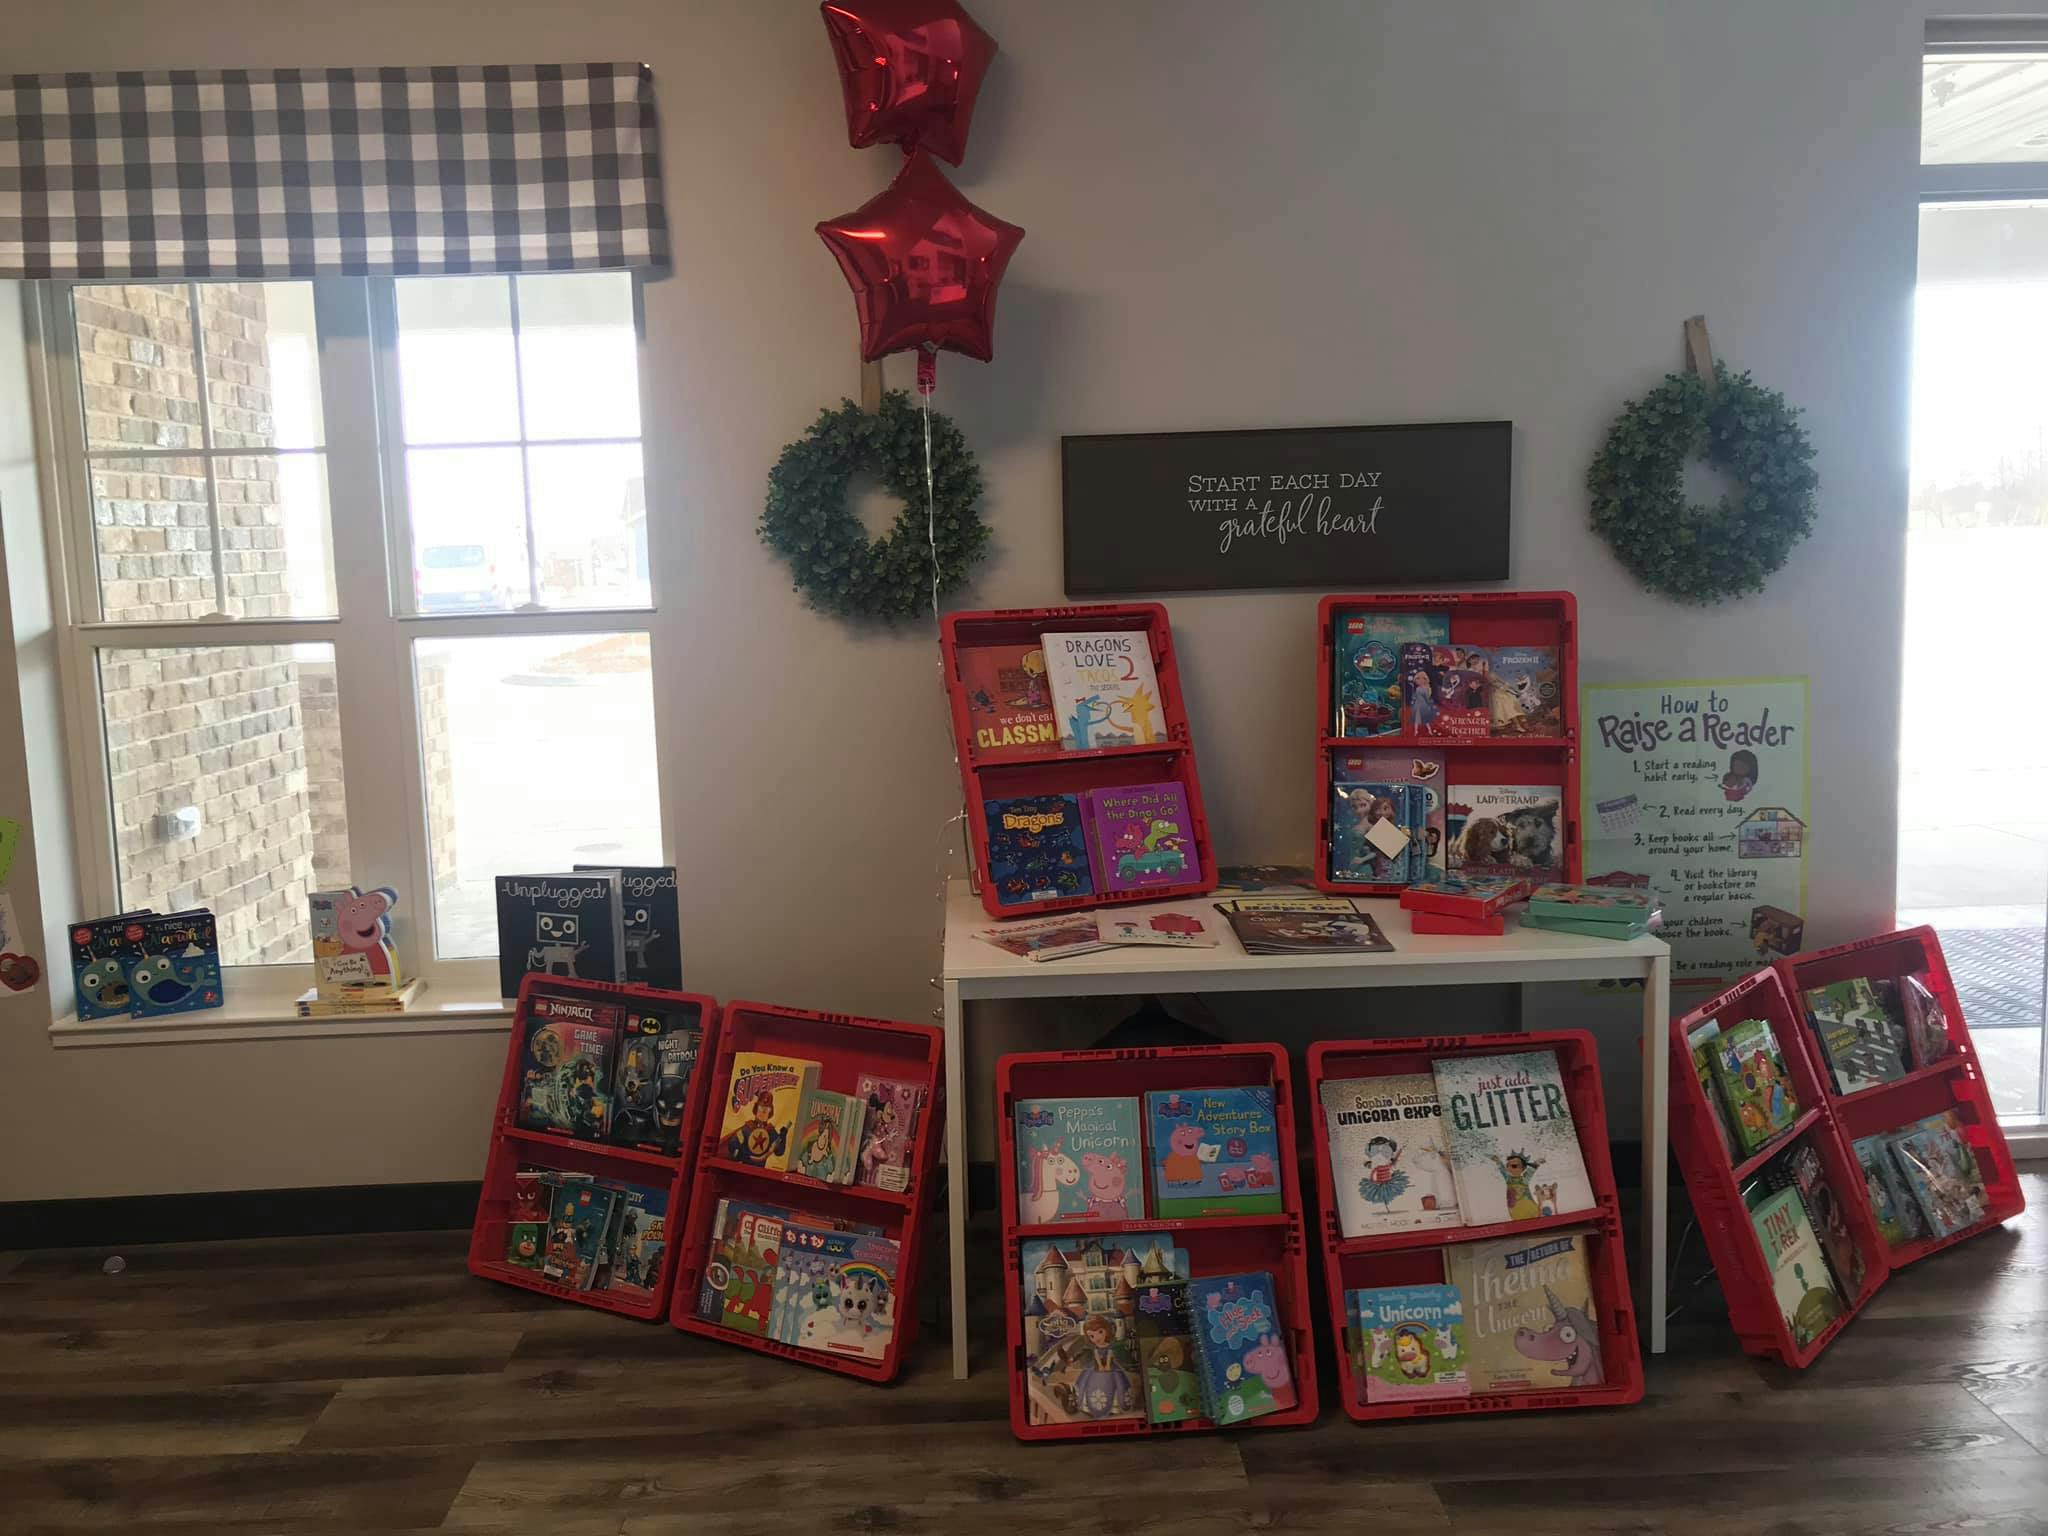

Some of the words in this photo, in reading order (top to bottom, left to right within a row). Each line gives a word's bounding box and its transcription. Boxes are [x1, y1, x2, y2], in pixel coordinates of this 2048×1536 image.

[1188, 474, 1261, 494] START
[1270, 473, 1330, 491] EACH
[1339, 471, 1383, 488] DAY
[1188, 498, 1238, 513] WITH
[1244, 497, 1259, 511] A
[1218, 493, 1313, 553] grateful
[1316, 495, 1385, 536] heart
[1065, 638, 1132, 653] DRAGONS
[1074, 653, 1117, 668] LOVE
[1117, 655, 1139, 682] 2
[1076, 669, 1119, 684] TACOS
[1661, 694, 1699, 714] How
[1707, 689, 1729, 713] to
[1000, 716, 1014, 725] we
[1015, 712, 1037, 723] don't
[976, 722, 1056, 749] CLASSM
[1597, 711, 1673, 753] Raise
[1678, 716, 1696, 742] a
[1702, 707, 1795, 750] Reader
[1645, 760, 1669, 770] Start
[1673, 761, 1679, 769] a
[1682, 759, 1717, 771] reading
[1644, 771, 1668, 782] habit
[1103, 796, 1138, 808] Where
[1142, 793, 1160, 805] Did
[1163, 792, 1178, 803] All
[1476, 794, 1499, 805] LADY
[1505, 794, 1539, 805] TRAMP
[1107, 810, 1125, 820] the
[1659, 805, 1670, 818] 2.
[1673, 805, 1696, 816] Read
[1699, 806, 1724, 817] every
[1003, 812, 1065, 833] Dragons
[1633, 832, 1645, 846] 3.
[1648, 833, 1670, 845] Keep
[1672, 832, 1699, 843] books
[1703, 831, 1714, 841] all
[1648, 843, 1680, 855] around
[1683, 845, 1705, 857] your
[1684, 868, 1704, 879] Visit
[1708, 868, 1724, 878] the
[1727, 867, 1758, 880] library
[622, 873, 677, 897] ugged
[1684, 882, 1694, 890] or
[1697, 880, 1741, 890] bookstore
[502, 880, 607, 908] Unplugged
[1693, 892, 1725, 905] regular
[1688, 916, 1723, 926] children
[1686, 927, 1701, 937] the
[1676, 960, 1686, 970] Be
[1699, 959, 1733, 972] reading
[574, 1029, 599, 1042] GAME
[658, 1038, 679, 1051] NIGHT
[739, 1067, 750, 1077] Do
[751, 1064, 766, 1073] You
[767, 1063, 788, 1072] Know
[1477, 1074, 1503, 1097] just
[1504, 1069, 1531, 1087] add
[1203, 1097, 1226, 1109] New
[1355, 1095, 1393, 1110] Sophie
[1451, 1083, 1569, 1131] GLITTER
[1058, 1105, 1104, 1121] Peppa's
[1196, 1109, 1262, 1122] Adventures
[1066, 1119, 1117, 1136] Magical
[1212, 1123, 1246, 1136] Story
[1249, 1120, 1271, 1134] Box
[1071, 1136, 1129, 1152] Unicorn
[1763, 1202, 1793, 1240] TINY
[757, 1222, 781, 1238] Cliffo
[1780, 1224, 1800, 1249] REX
[1510, 1254, 1526, 1267] THE
[1470, 1255, 1570, 1307] Thelma
[1380, 1304, 1442, 1323] Unicorn
